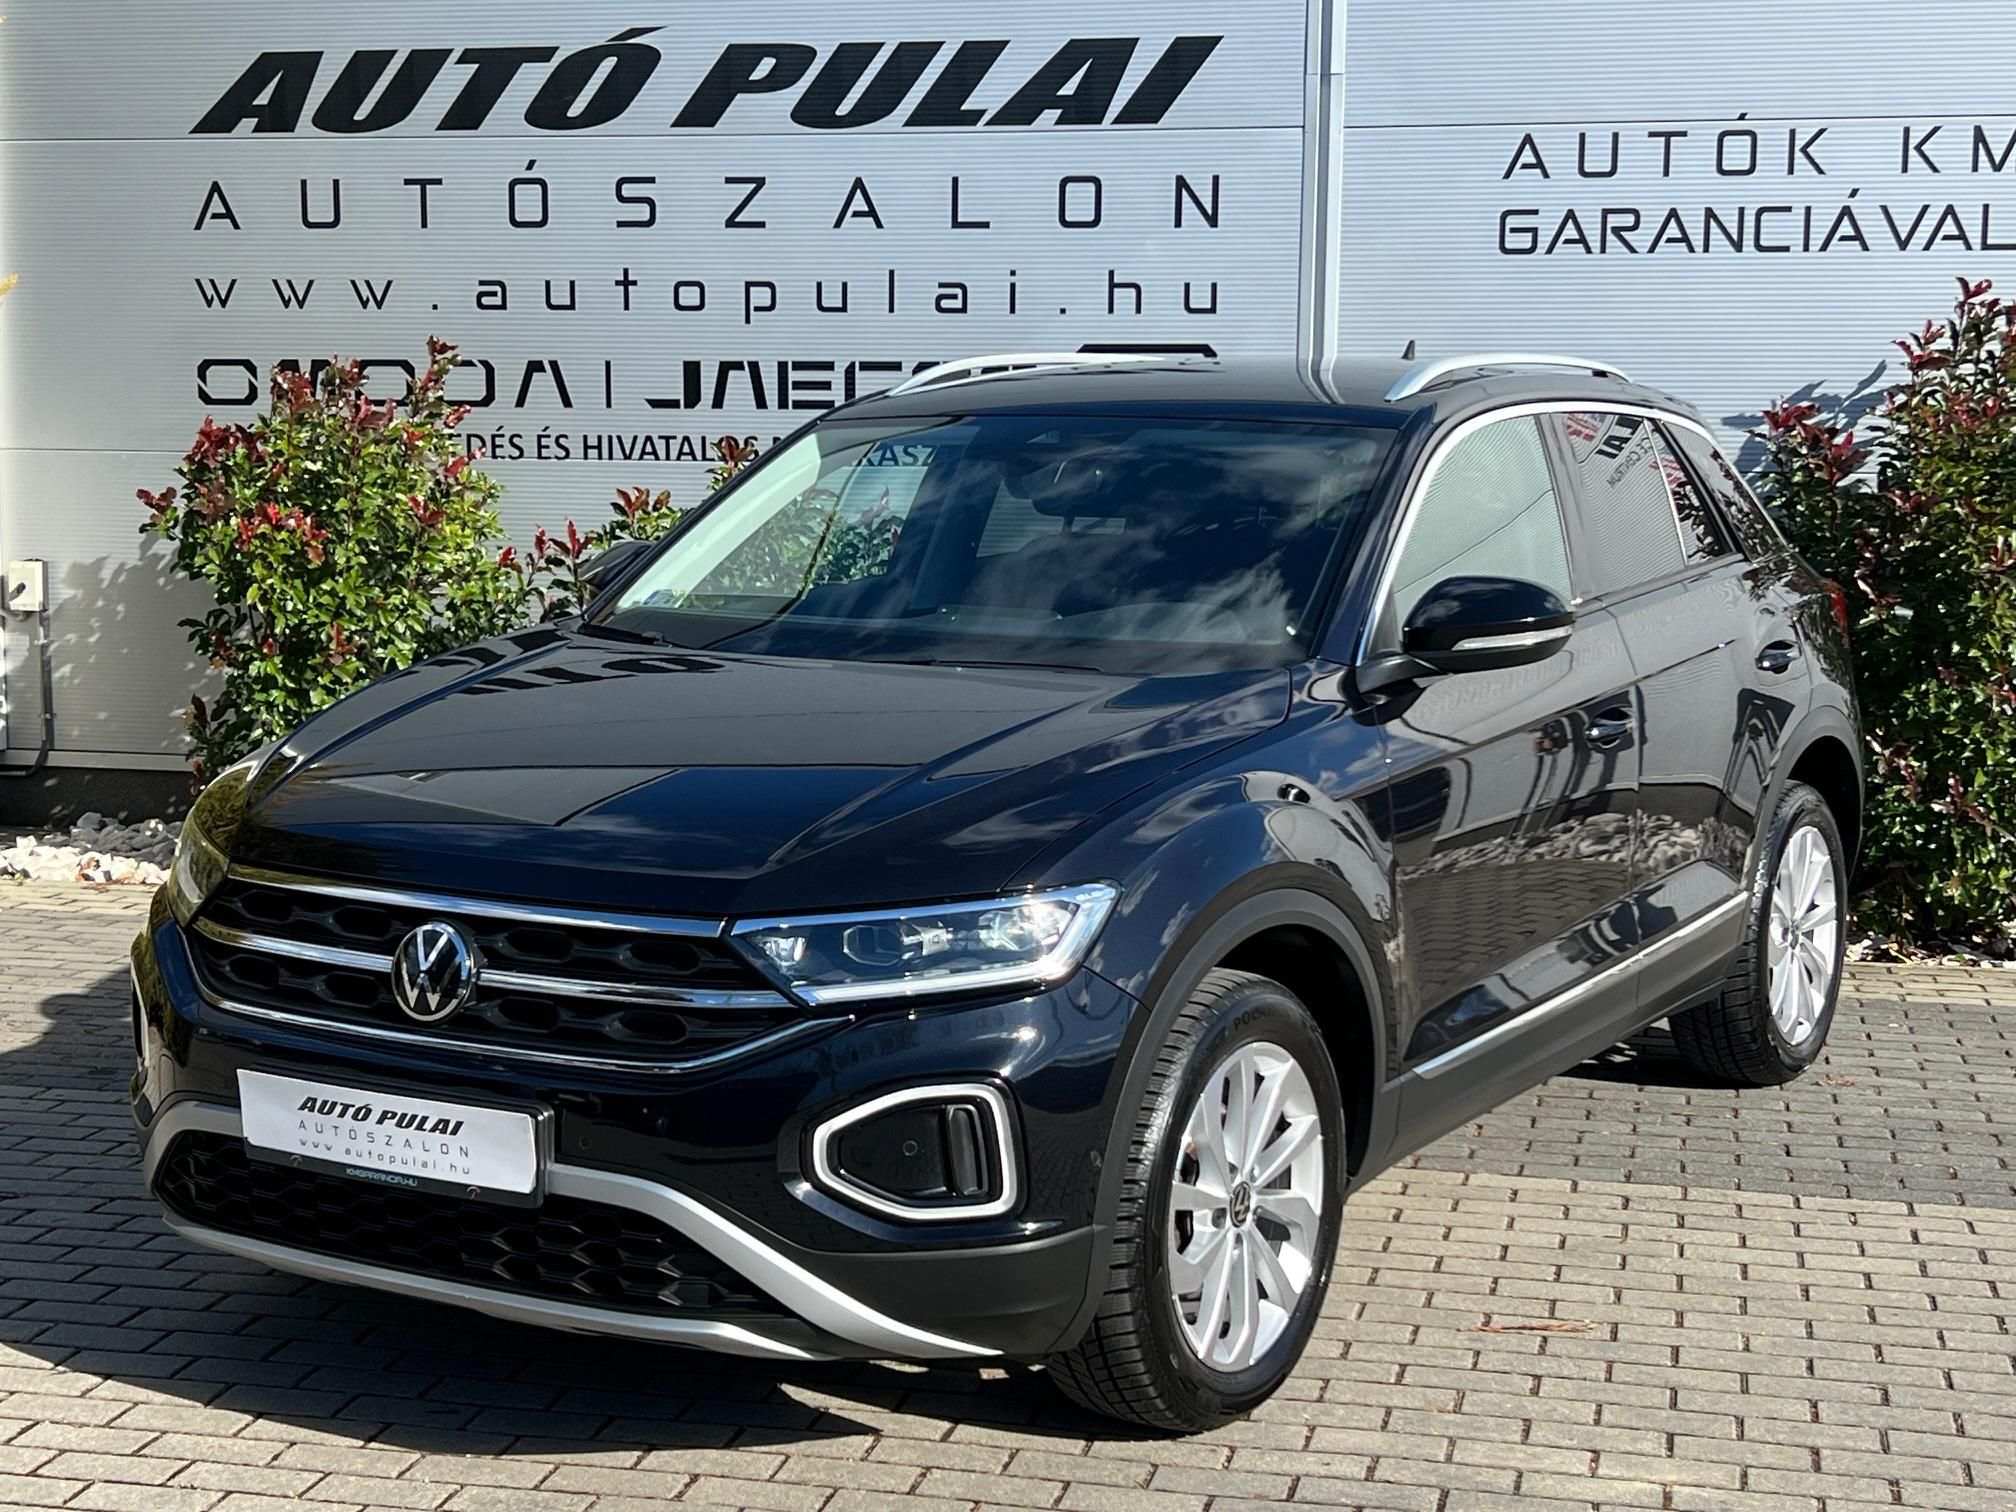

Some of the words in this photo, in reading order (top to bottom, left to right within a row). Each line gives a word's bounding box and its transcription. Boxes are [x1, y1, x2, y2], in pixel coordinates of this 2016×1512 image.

[188, 26, 668, 134] AUTÓ
[670, 35, 1224, 129] PULAI
[1502, 112, 1829, 180] AUTÓK
[193, 159, 1220, 231] AUTÓSZALON
[1498, 188, 2016, 255] GARANCIÁVAL
[194, 267, 1218, 325] www.autopulai.hu
[536, 425, 571, 461] ÉS
[297, 1096, 372, 1123] AUTÓ
[375, 1111, 464, 1136] PULAI
[298, 1119, 469, 1158] AUTÓSZALON
